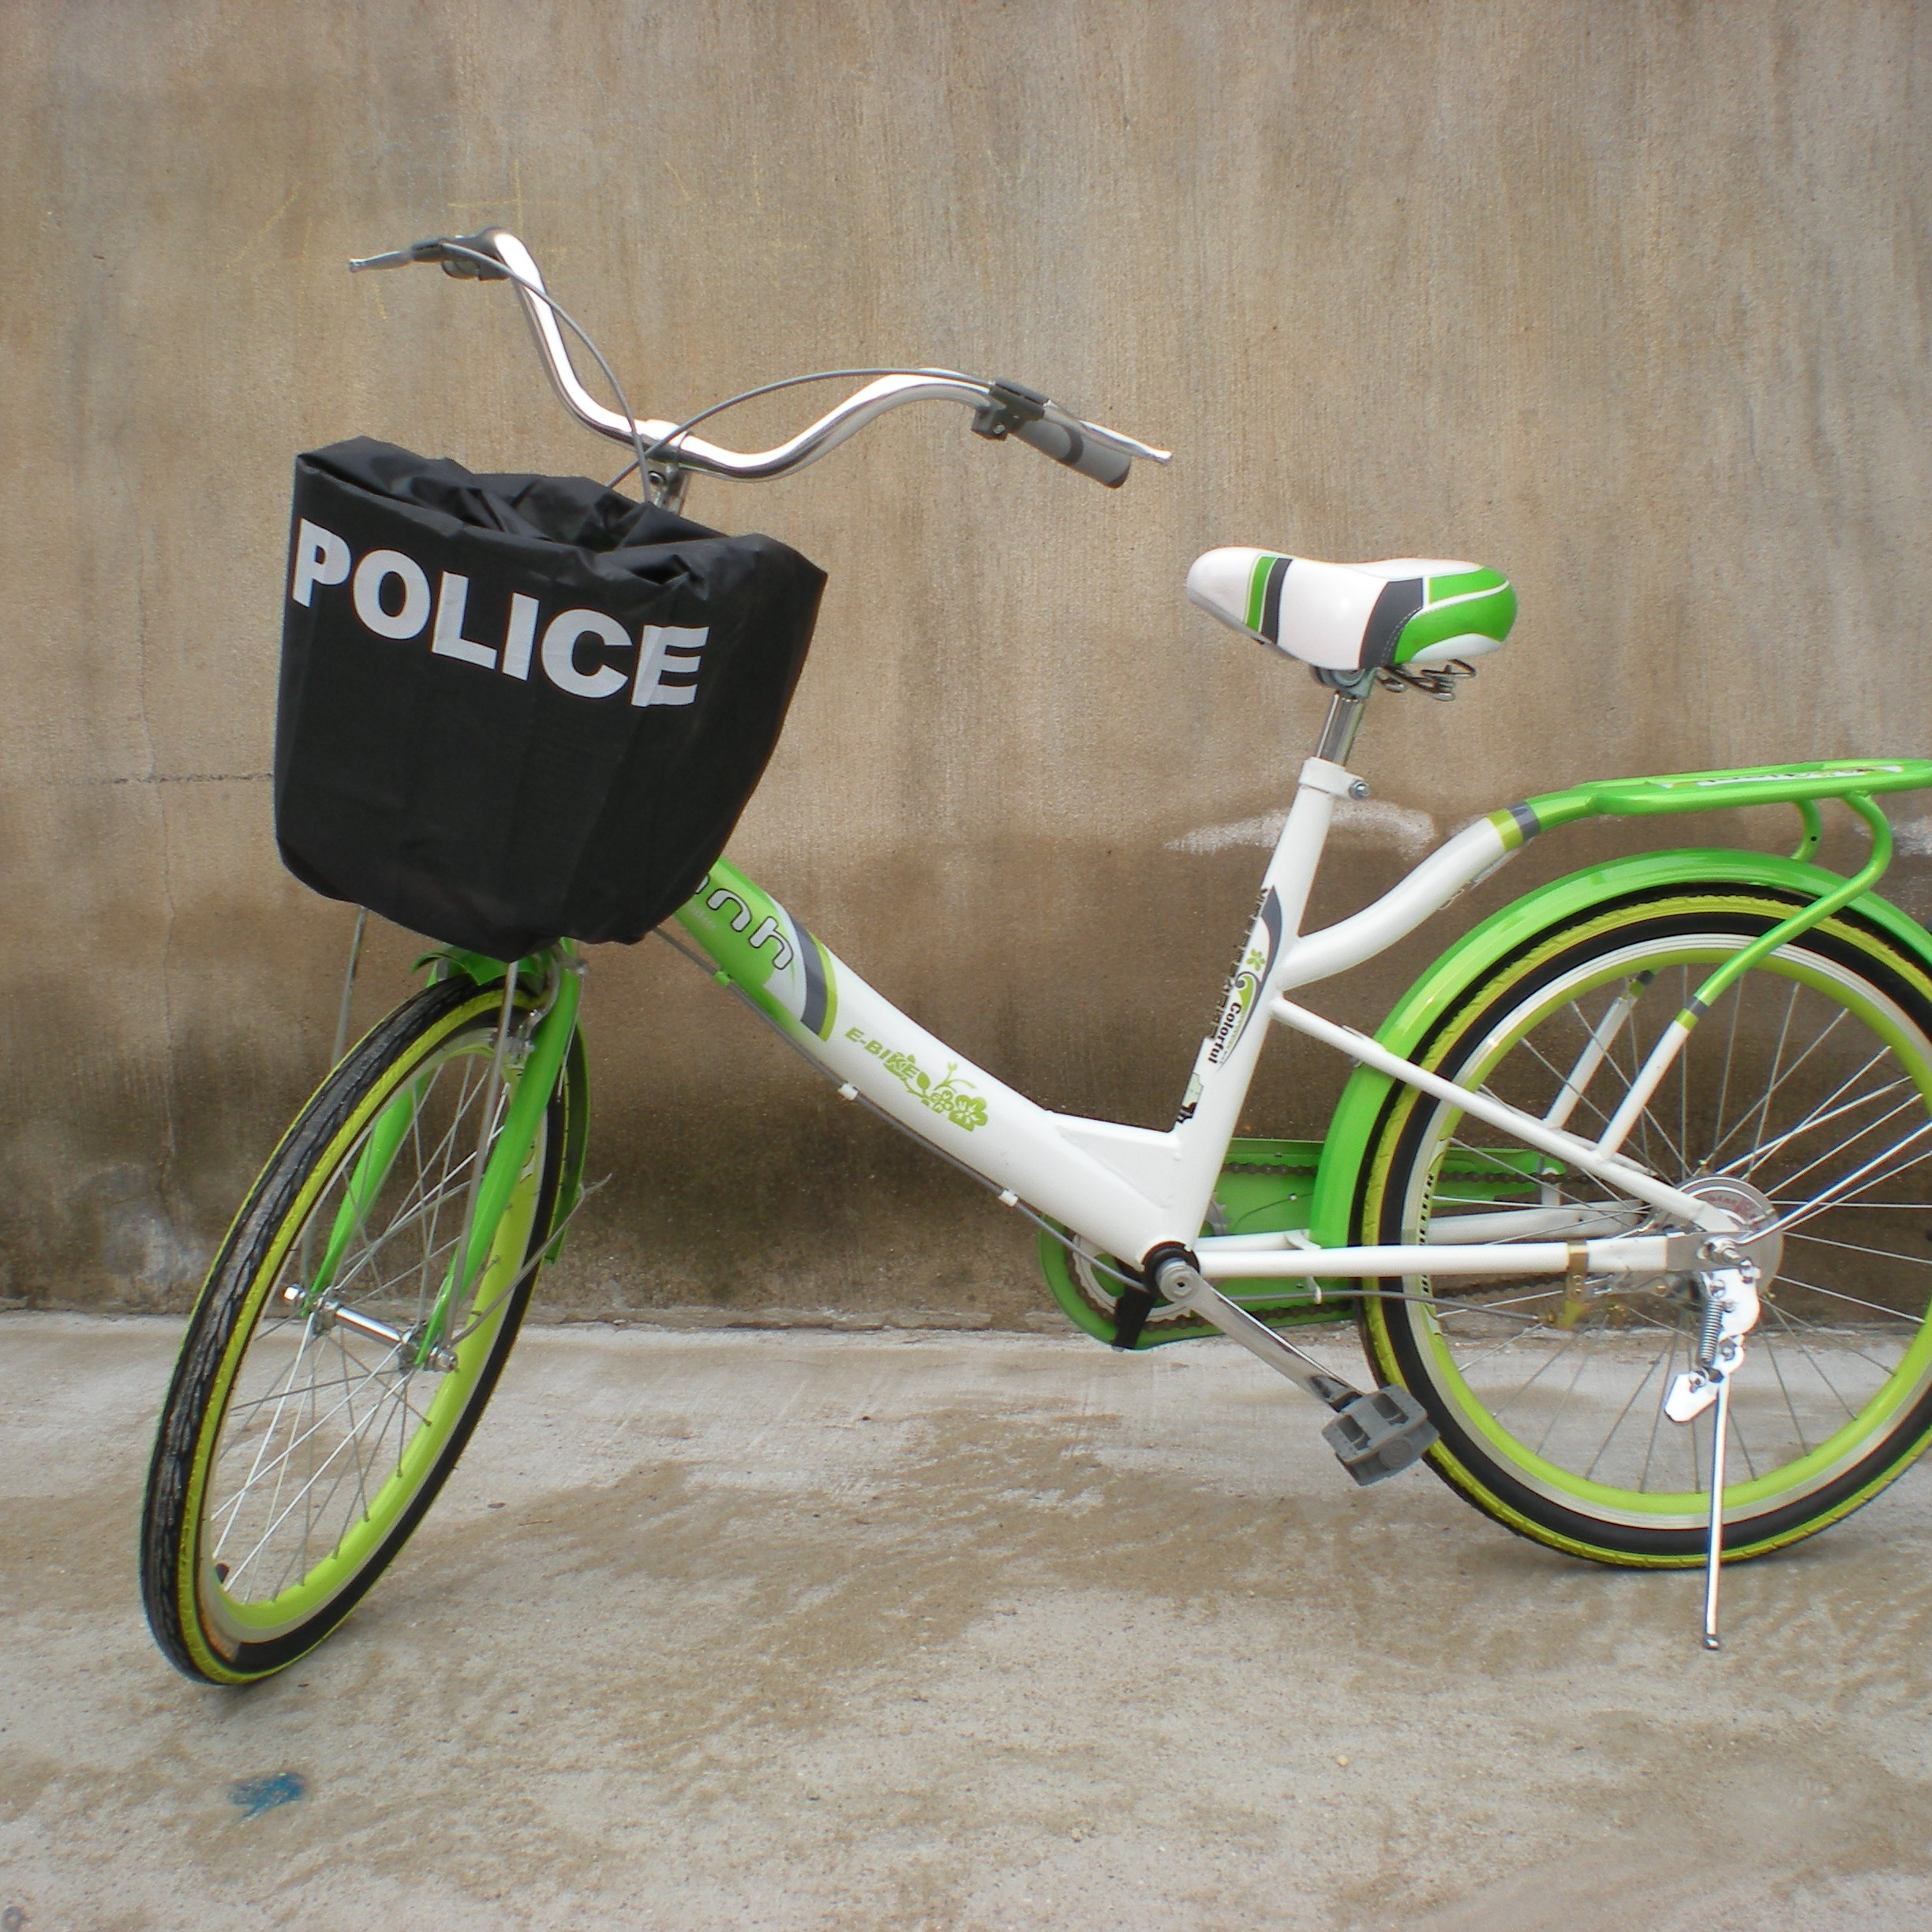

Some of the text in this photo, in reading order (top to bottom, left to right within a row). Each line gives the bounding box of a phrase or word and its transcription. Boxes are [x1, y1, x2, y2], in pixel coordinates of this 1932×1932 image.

[292, 518, 710, 706] POLICE
[695, 874, 794, 970] nh
[844, 1028, 919, 1079] E-BIKE
[1208, 1002, 1241, 1064] Colorful
